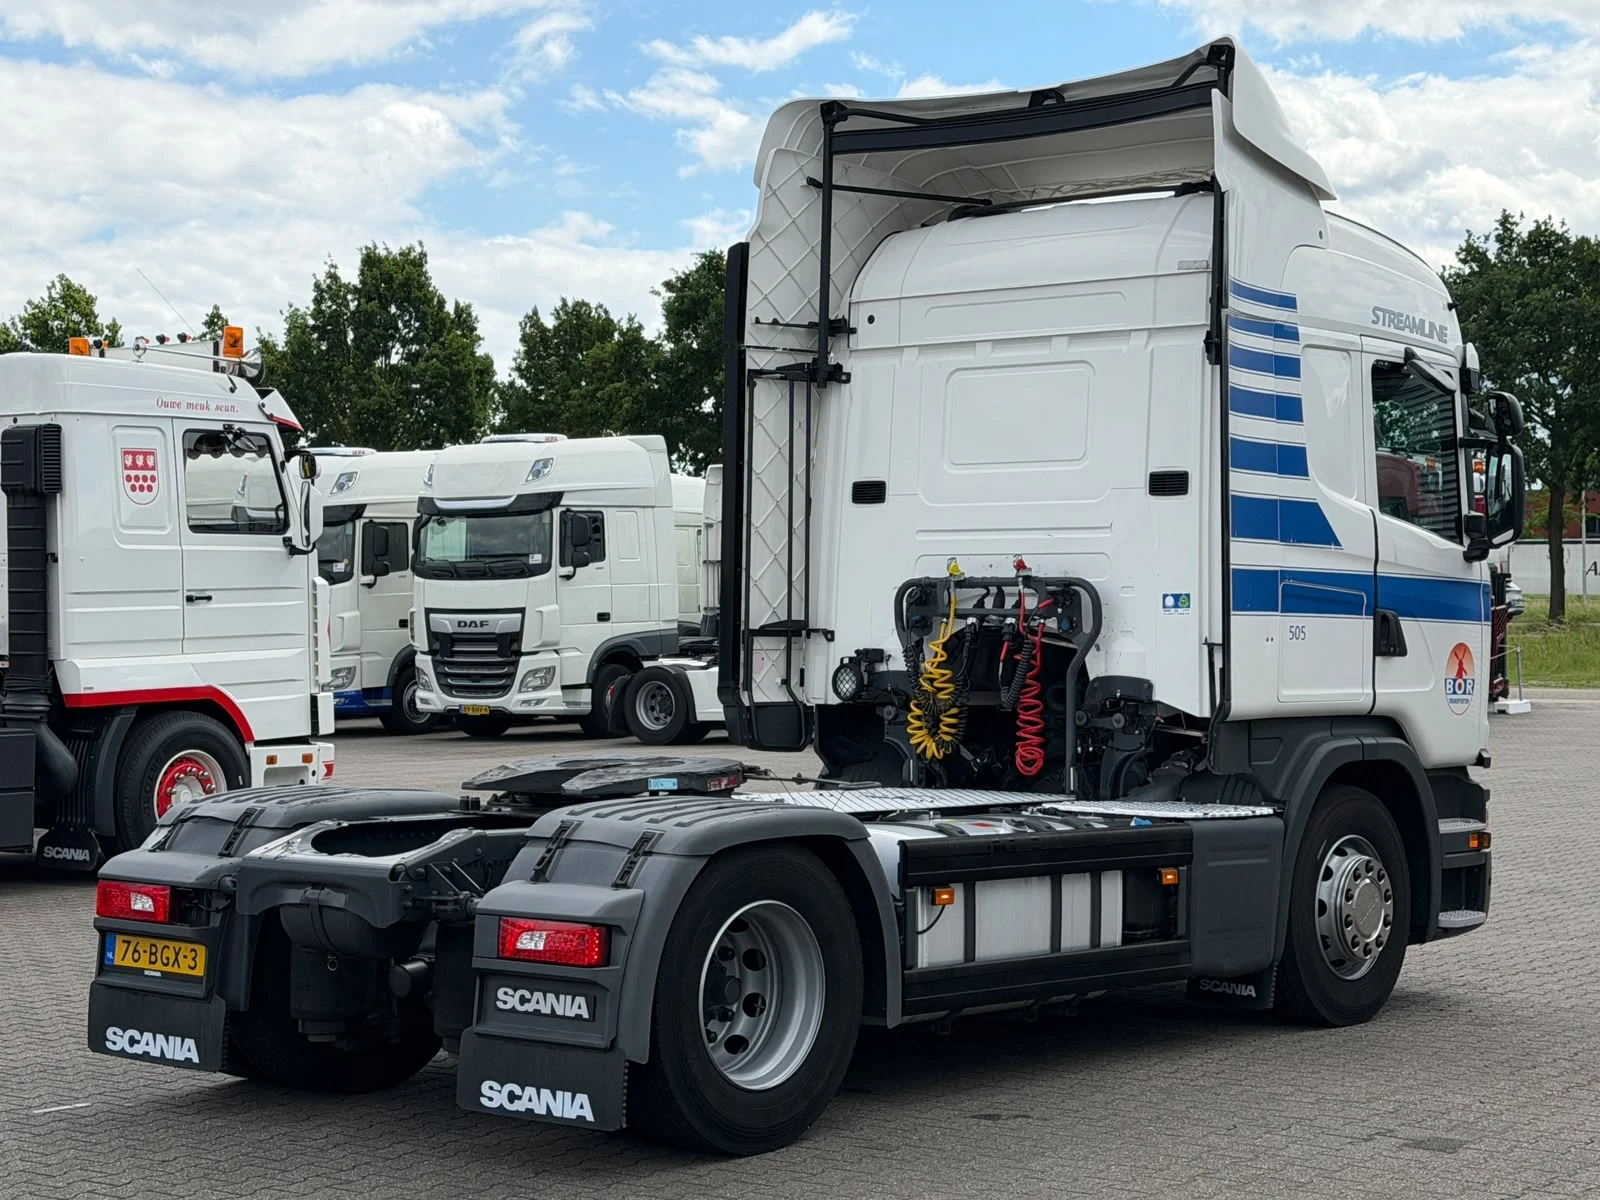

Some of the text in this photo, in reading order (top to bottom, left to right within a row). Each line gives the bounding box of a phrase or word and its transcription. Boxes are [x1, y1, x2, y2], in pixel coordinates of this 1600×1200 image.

[1371, 305, 1448, 344] STREAMLINE
[156, 396, 182, 409] Ouwe
[186, 400, 211, 411] meuk
[457, 620, 489, 628] DAF
[1289, 625, 1306, 641] 505
[1446, 679, 1474, 695] BOR
[43, 846, 91, 861] SCANIA
[120, 939, 199, 971] 76-BGX-3
[1199, 979, 1257, 998] SCANIA
[495, 987, 590, 1019] SCANIA
[105, 1026, 200, 1064] SCANIA
[479, 1080, 595, 1122] SCANIA
